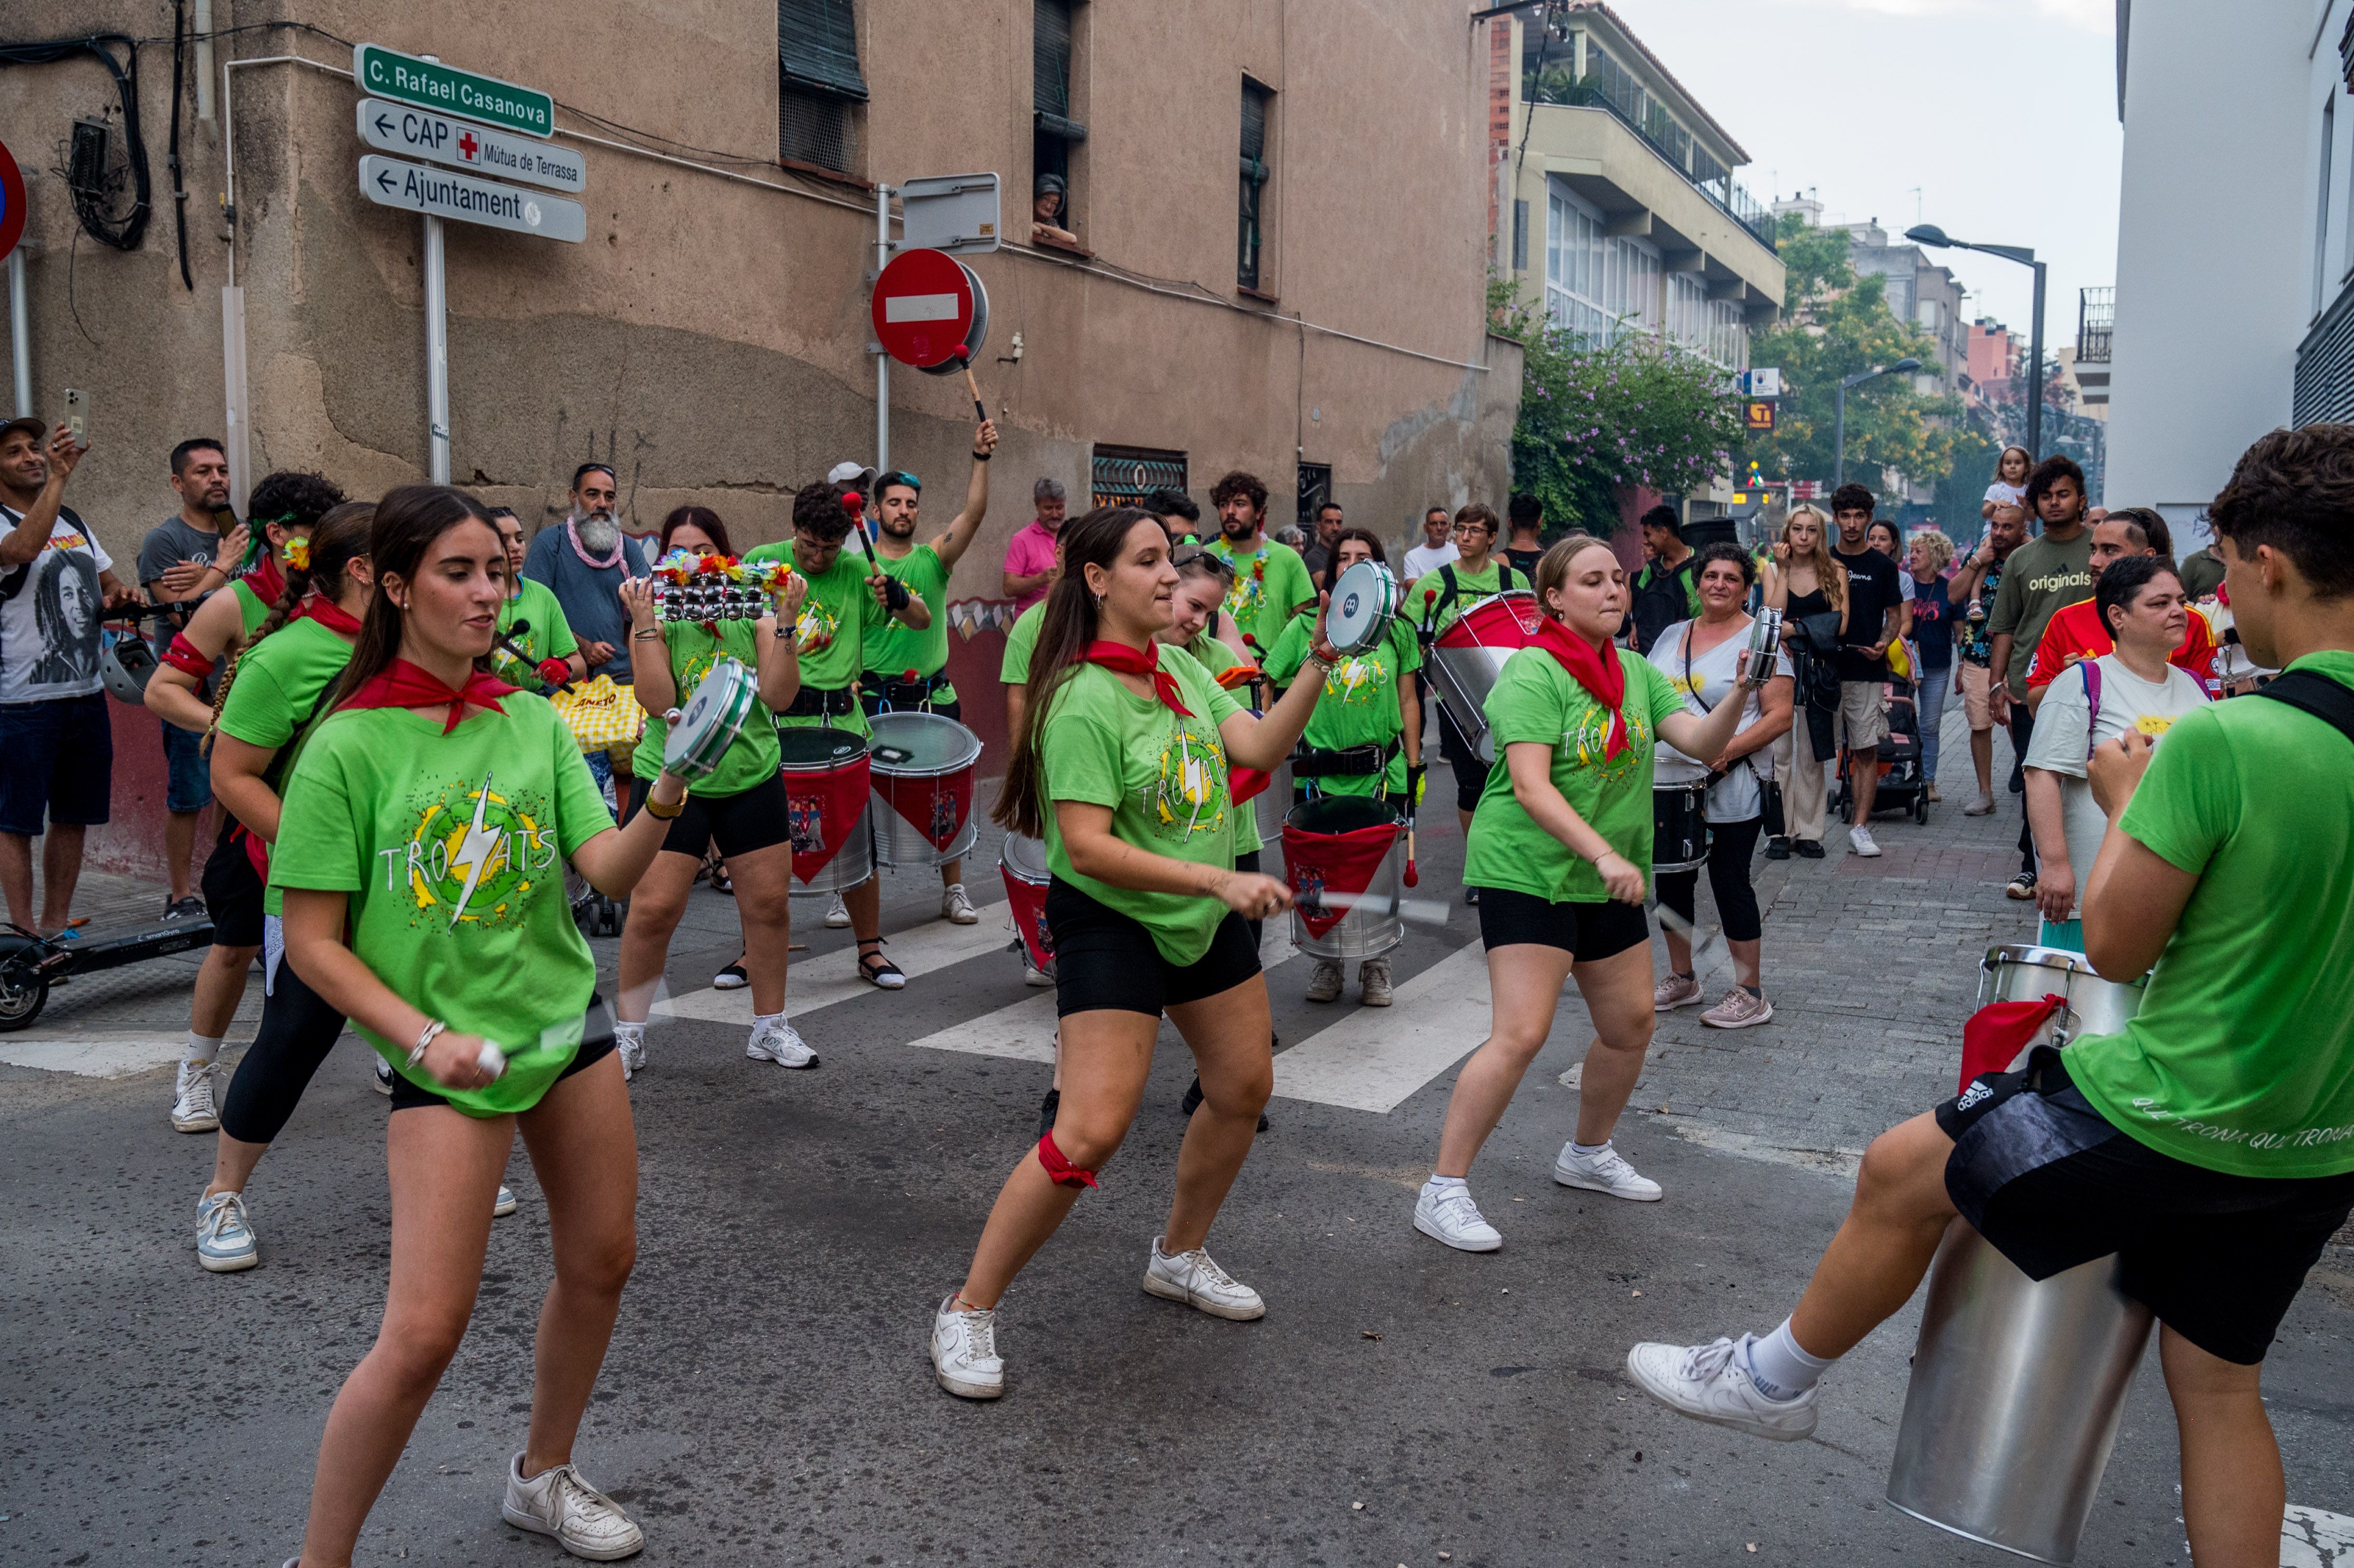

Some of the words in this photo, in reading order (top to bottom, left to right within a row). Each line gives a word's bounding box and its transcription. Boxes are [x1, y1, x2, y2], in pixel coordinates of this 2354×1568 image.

[370, 59, 389, 84] C.
[395, 66, 455, 101] Rafael
[460, 84, 545, 124] Casanova
[402, 113, 448, 150] CAP
[484, 142, 517, 168] Mútua
[519, 152, 533, 171] de
[535, 155, 578, 182] Terrassa
[404, 168, 520, 219] Ajuntament
[1848, 570, 1872, 582] Jeans
[2029, 571, 2091, 592] originals
[574, 694, 617, 708] ANETO
[146, 929, 179, 940] smartGyro
[1957, 1088, 1994, 1111] adidas
